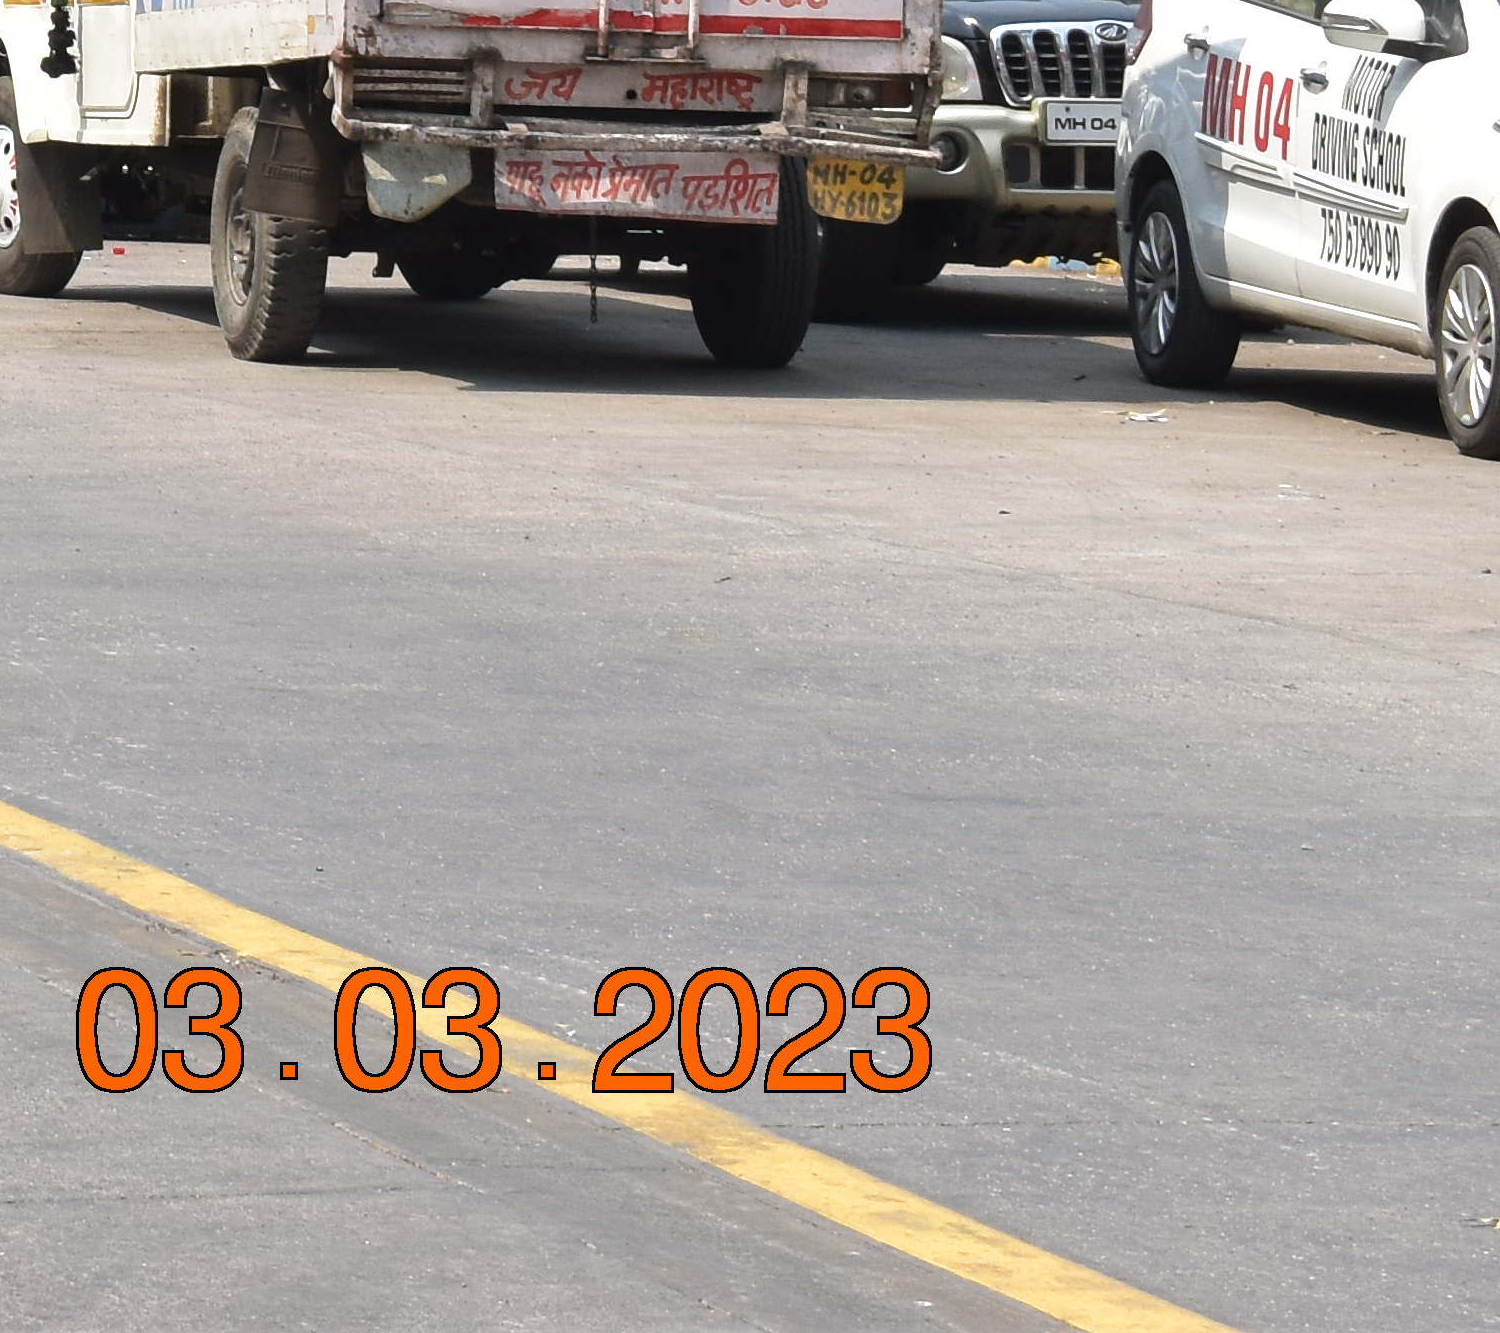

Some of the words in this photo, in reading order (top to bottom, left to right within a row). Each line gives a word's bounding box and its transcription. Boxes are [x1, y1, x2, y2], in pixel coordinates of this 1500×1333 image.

[504, 67, 583, 101] जय
[1202, 53, 1252, 146] MH
[1254, 70, 1294, 161] 04
[1341, 54, 1397, 121] MOTOR
[1054, 117, 1087, 131] MH
[1090, 117, 1118, 131] 04
[812, 163, 898, 192] MH-04
[1311, 111, 1360, 183] DRIVING
[1360, 126, 1407, 198] SCHOOL
[812, 188, 902, 220] HY-6103
[1319, 207, 1343, 265] 750
[1345, 213, 1383, 273] 67890
[1384, 224, 1400, 282] 90
